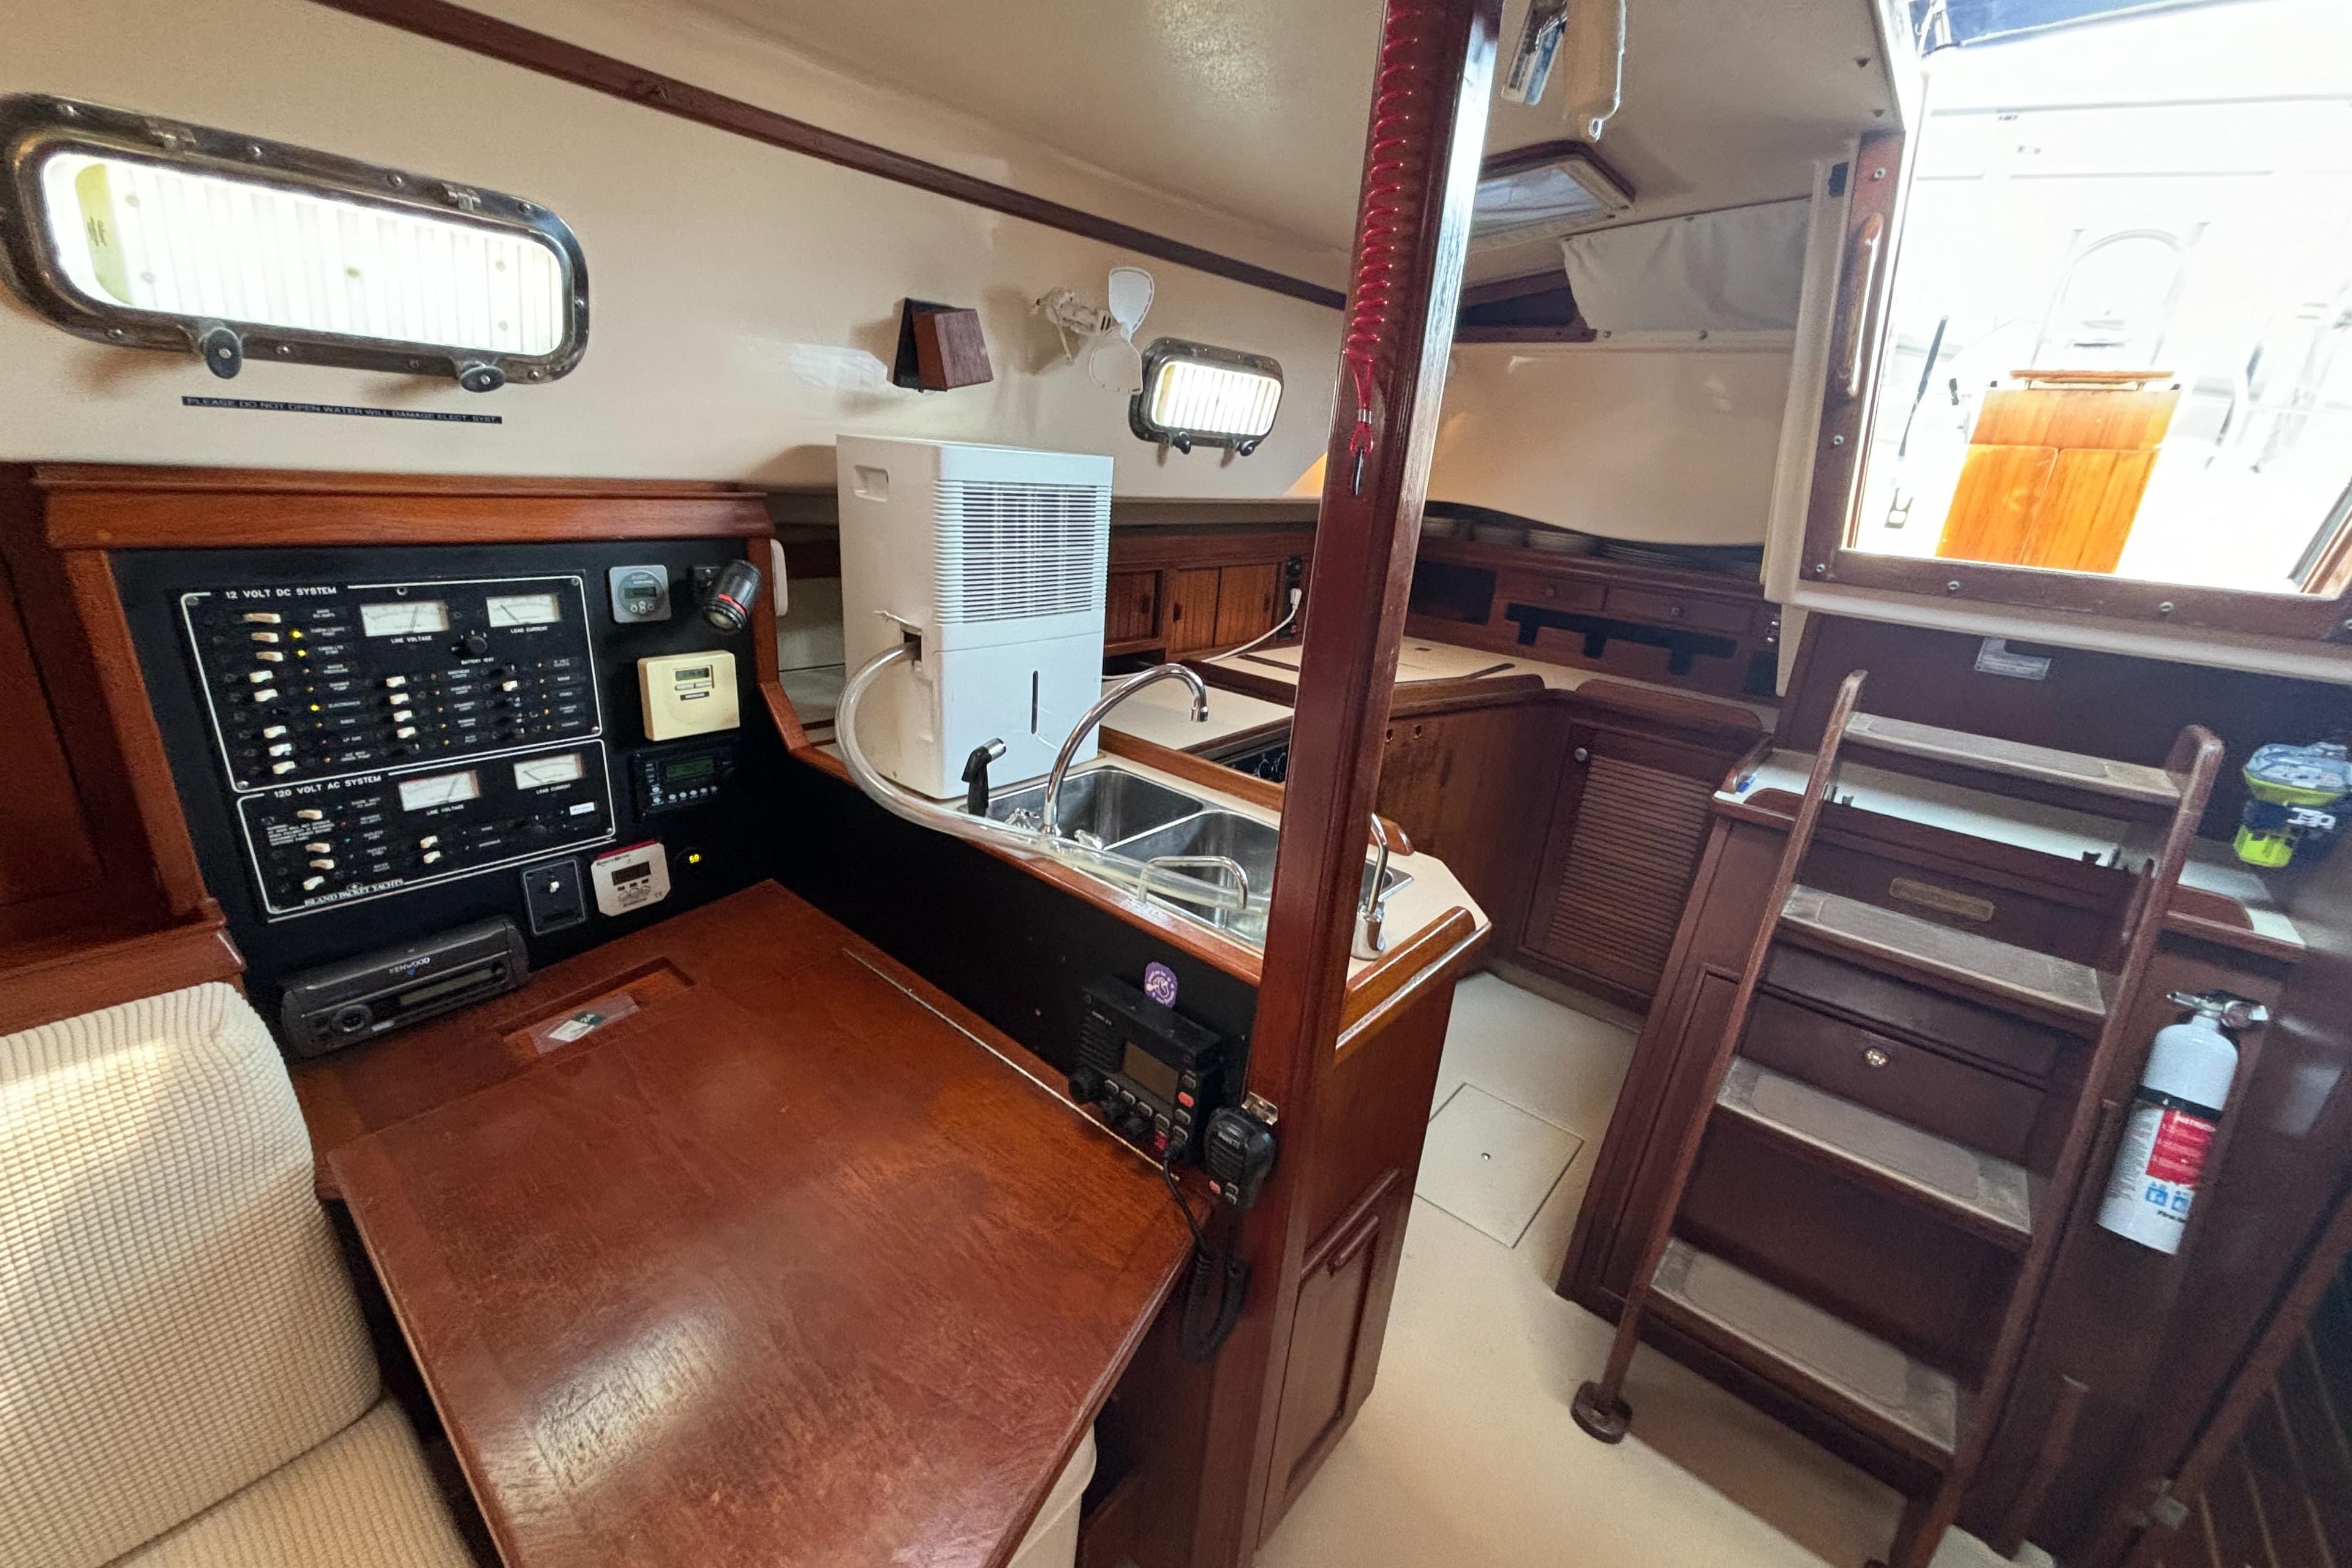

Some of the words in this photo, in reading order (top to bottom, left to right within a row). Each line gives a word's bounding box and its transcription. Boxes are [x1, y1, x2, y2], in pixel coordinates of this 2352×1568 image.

[186, 398, 236, 407] PLEASE
[288, 403, 320, 412] OPEN
[323, 406, 363, 415] WATER
[393, 411, 434, 420] DAMAGE
[243, 589, 271, 598] VOLT
[277, 588, 292, 597] DC
[296, 586, 337, 595] SYSTEM
[274, 790, 292, 798] 120
[296, 784, 322, 794] VOLT
[345, 775, 382, 787] SYSTEM
[442, 804, 464, 813] VOLTAGE
[338, 886, 371, 899] PACKET
[371, 878, 404, 892] YACHTS
[390, 957, 431, 974] KENWOOD
